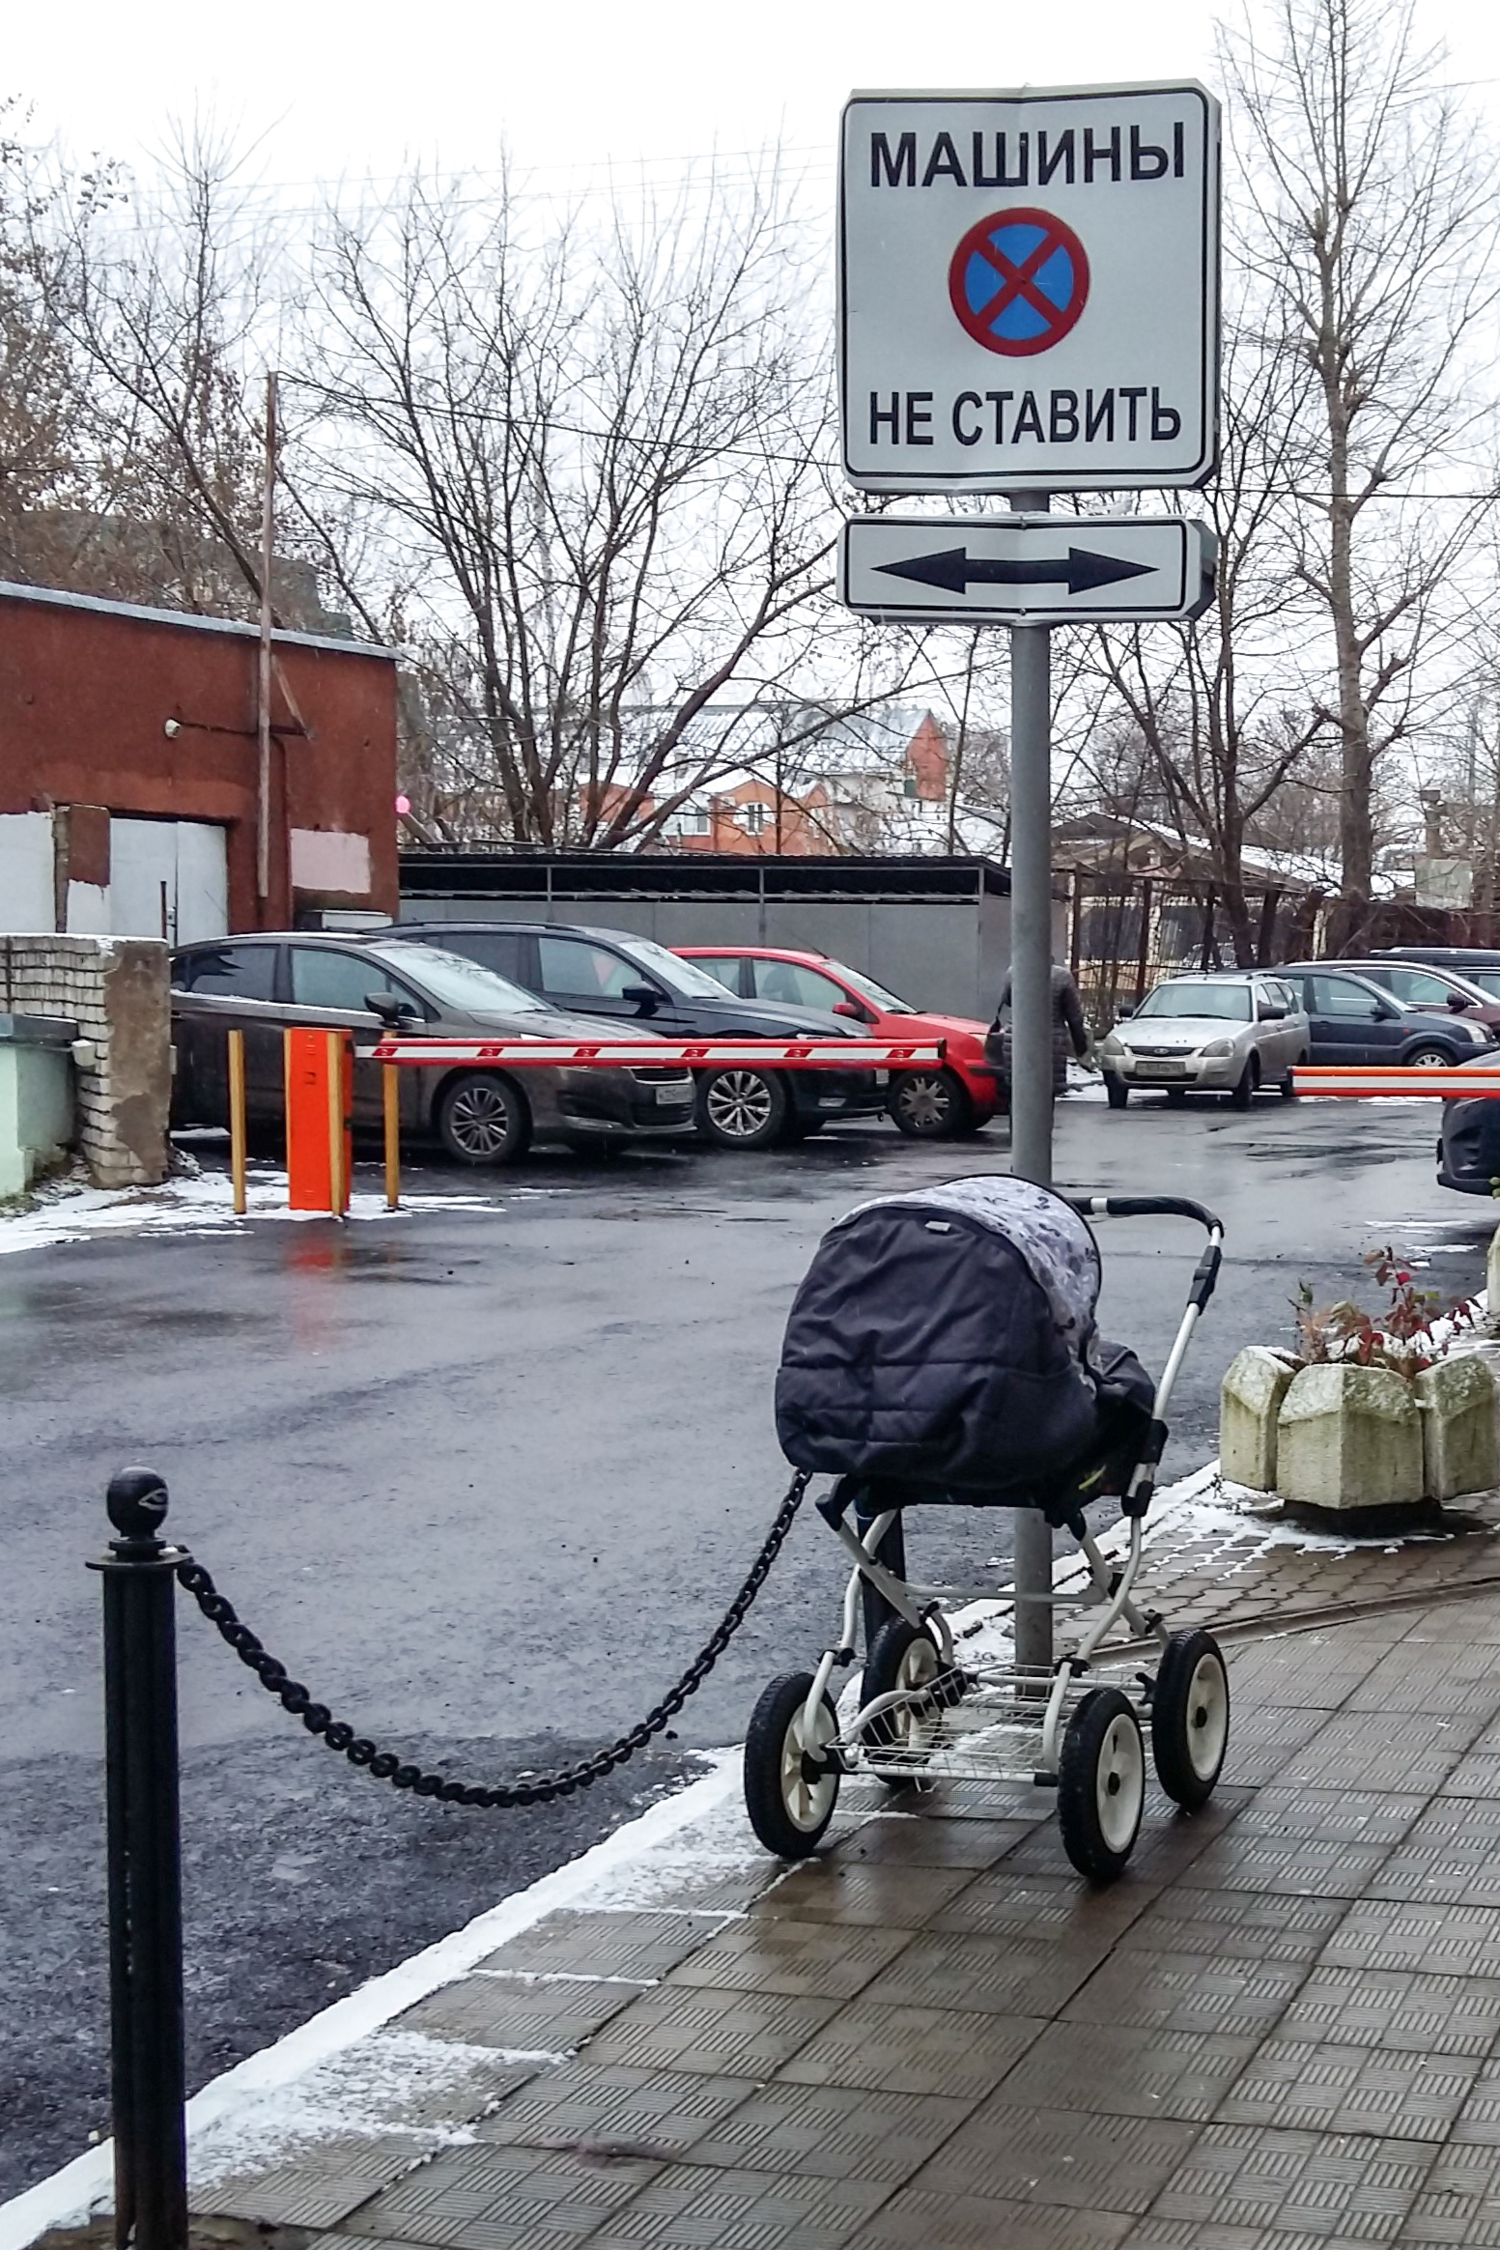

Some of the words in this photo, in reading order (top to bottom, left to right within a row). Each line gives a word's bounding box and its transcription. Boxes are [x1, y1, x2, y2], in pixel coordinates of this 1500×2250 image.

[870, 121, 1184, 188] МАШИНЫ
[869, 391, 934, 446] НЕ
[952, 387, 1182, 446] СТАВИТЬ
